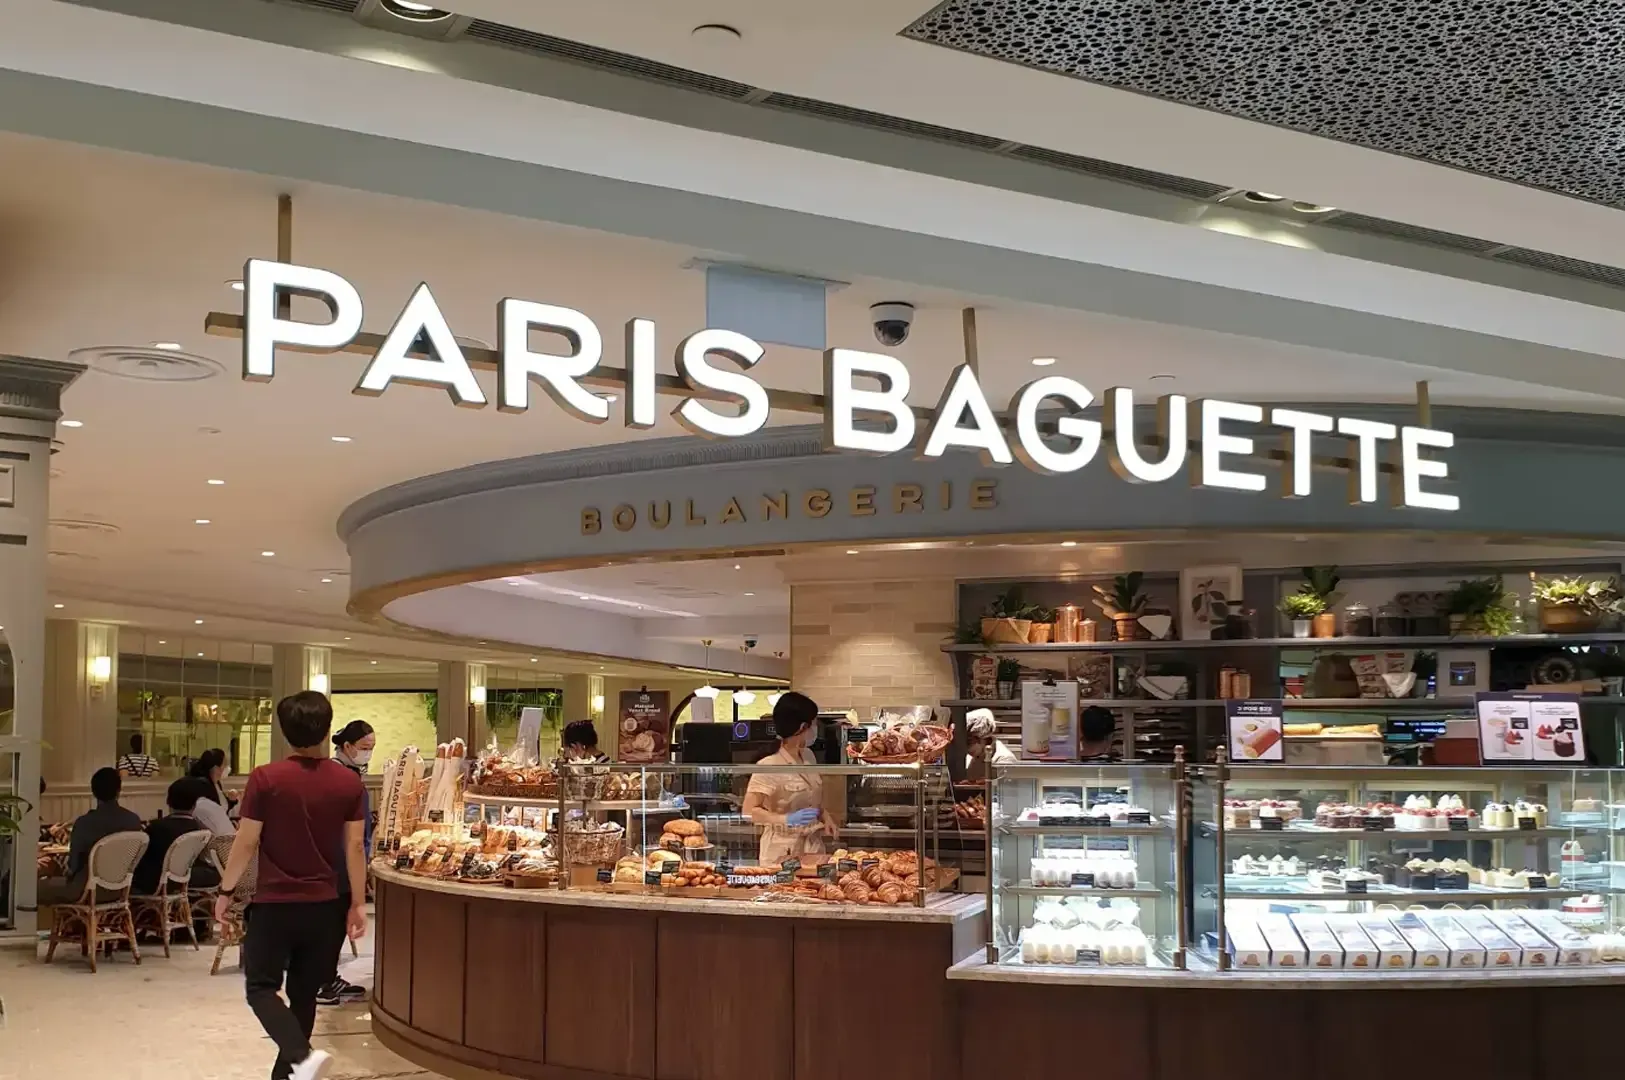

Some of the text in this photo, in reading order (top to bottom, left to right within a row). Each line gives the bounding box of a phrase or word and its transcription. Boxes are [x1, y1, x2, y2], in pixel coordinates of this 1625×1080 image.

[244, 258, 1460, 511] PARIS BAGUETTE
[580, 479, 998, 536] BOULANGERIE
[387, 780, 403, 836] BAGUETTE
